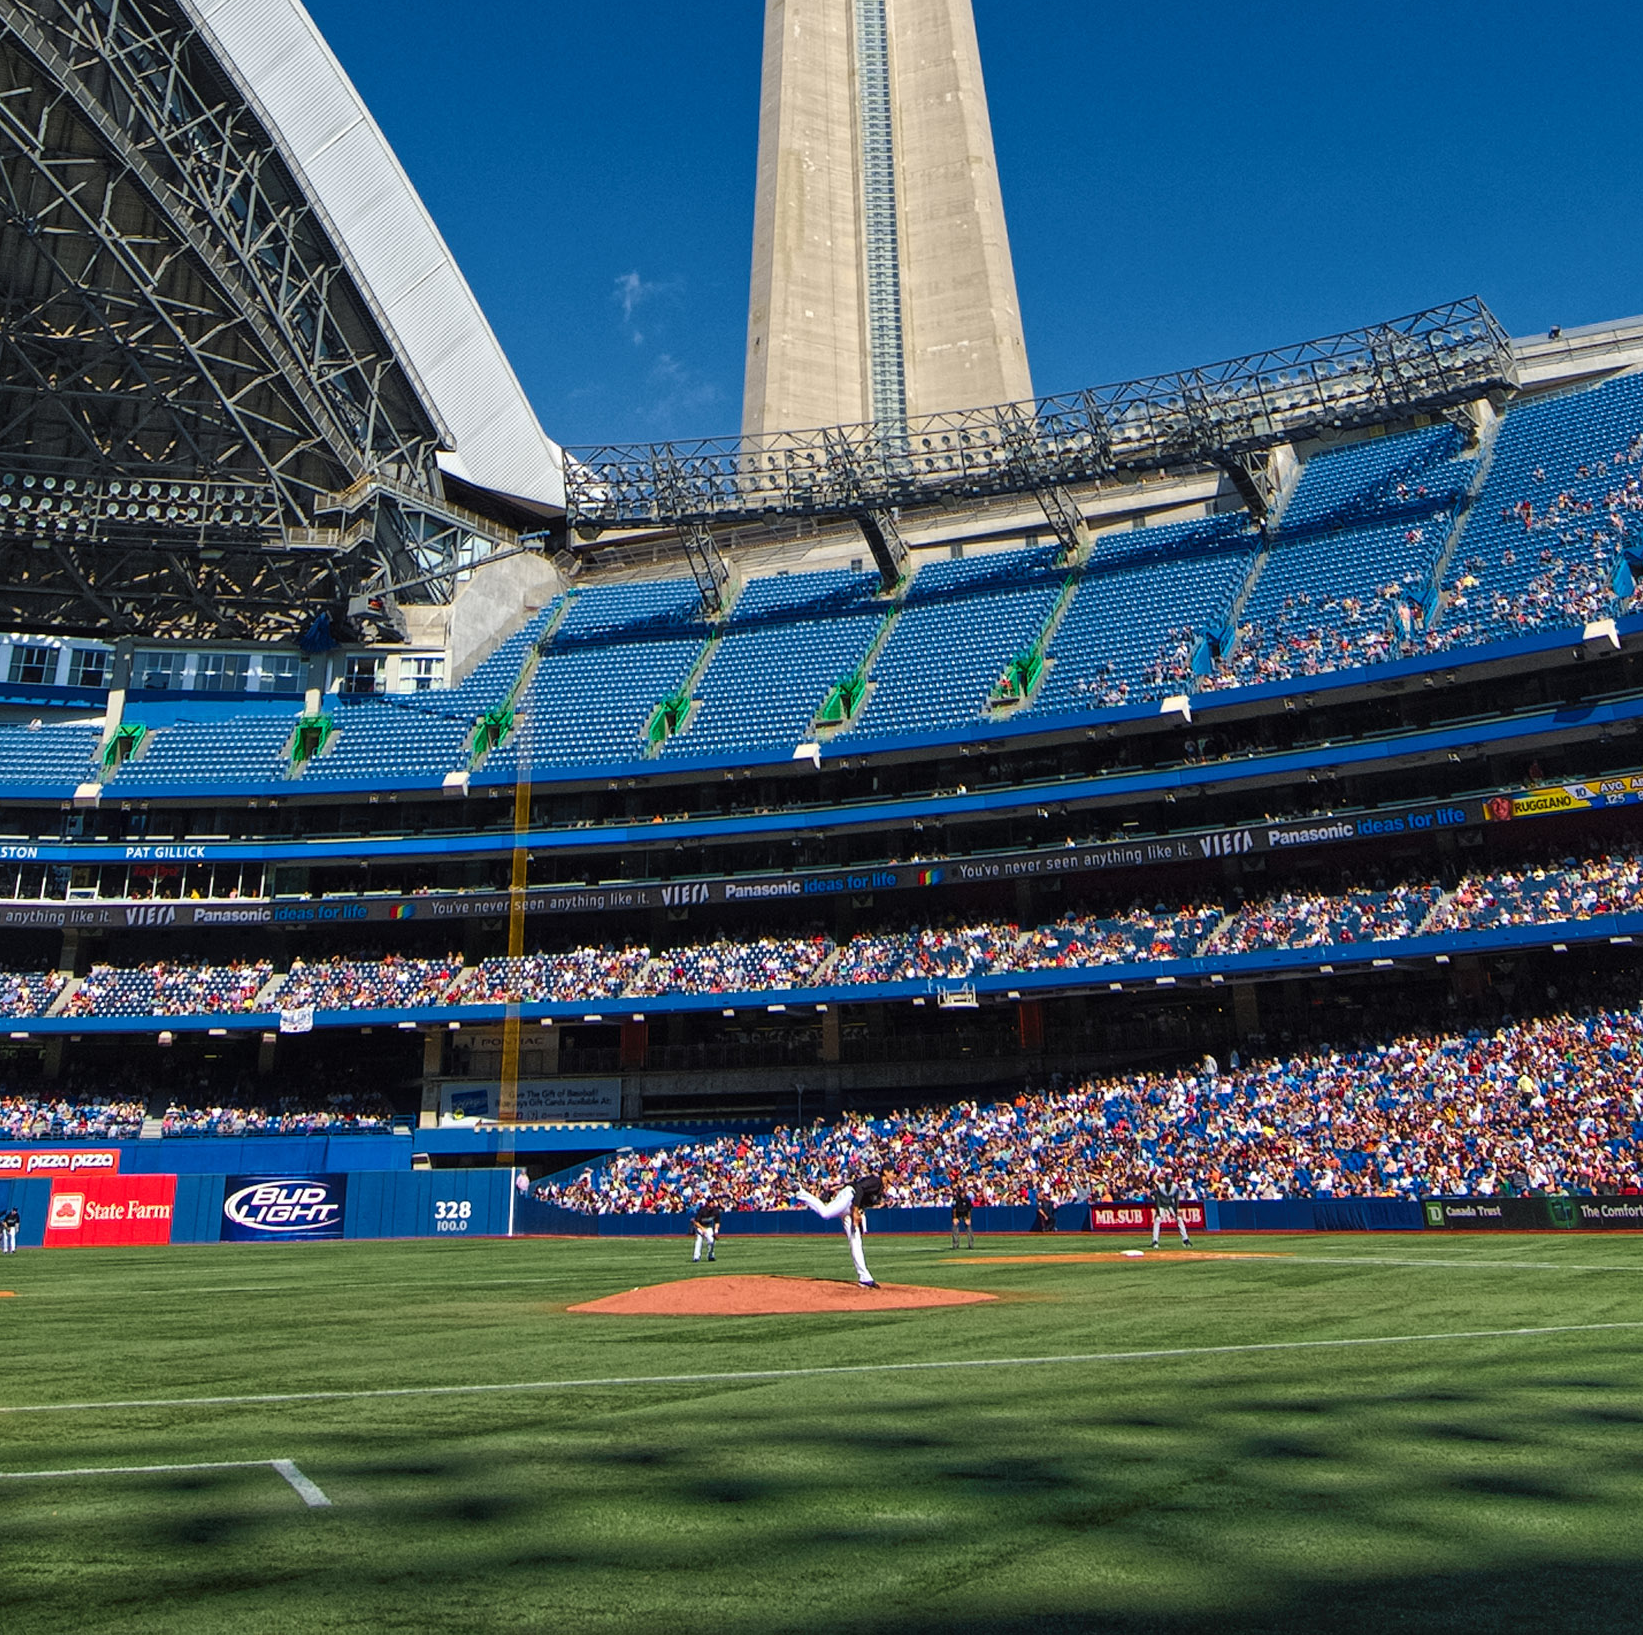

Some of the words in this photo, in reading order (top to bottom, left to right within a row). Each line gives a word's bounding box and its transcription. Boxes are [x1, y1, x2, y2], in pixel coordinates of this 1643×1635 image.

[1514, 794, 1572, 814] RUGGIANO
[1574, 787, 1588, 799] 10
[1267, 820, 1355, 848] Panasonic
[1357, 815, 1405, 837] ideas
[1406, 812, 1434, 831] for
[1435, 807, 1466, 827] life
[125, 846, 152, 859] PAT
[153, 845, 207, 859] GILLICK
[959, 862, 1000, 880] You've
[1004, 860, 1042, 875] never
[1045, 856, 1079, 871] seen
[1084, 850, 1143, 868] anything
[1147, 845, 1173, 860] like
[1177, 841, 1193, 858] it.
[724, 880, 801, 900] Panasonic
[803, 877, 844, 894] ideas
[846, 875, 870, 890] for
[871, 871, 897, 888] life
[5, 909, 65, 927] anything
[69, 907, 97, 923] like
[98, 908, 114, 923] it.
[192, 907, 272, 924] Panasonic
[273, 905, 315, 921] ideas
[316, 905, 342, 920] for
[342, 903, 368, 920] life
[26, 1153, 70, 1173] pizza
[69, 1152, 114, 1172] pizza
[250, 1186, 328, 1206] BUD
[84, 1200, 125, 1221] State
[125, 1200, 171, 1220] Farm
[238, 1202, 337, 1223] LIGHT
[434, 1200, 472, 1219] 328
[1094, 1208, 1144, 1225] MR.SUB
[1445, 1205, 1477, 1217] Canada
[1477, 1206, 1503, 1217] Trust
[1579, 1204, 1601, 1218] The
[436, 1219, 468, 1232] 100.0
